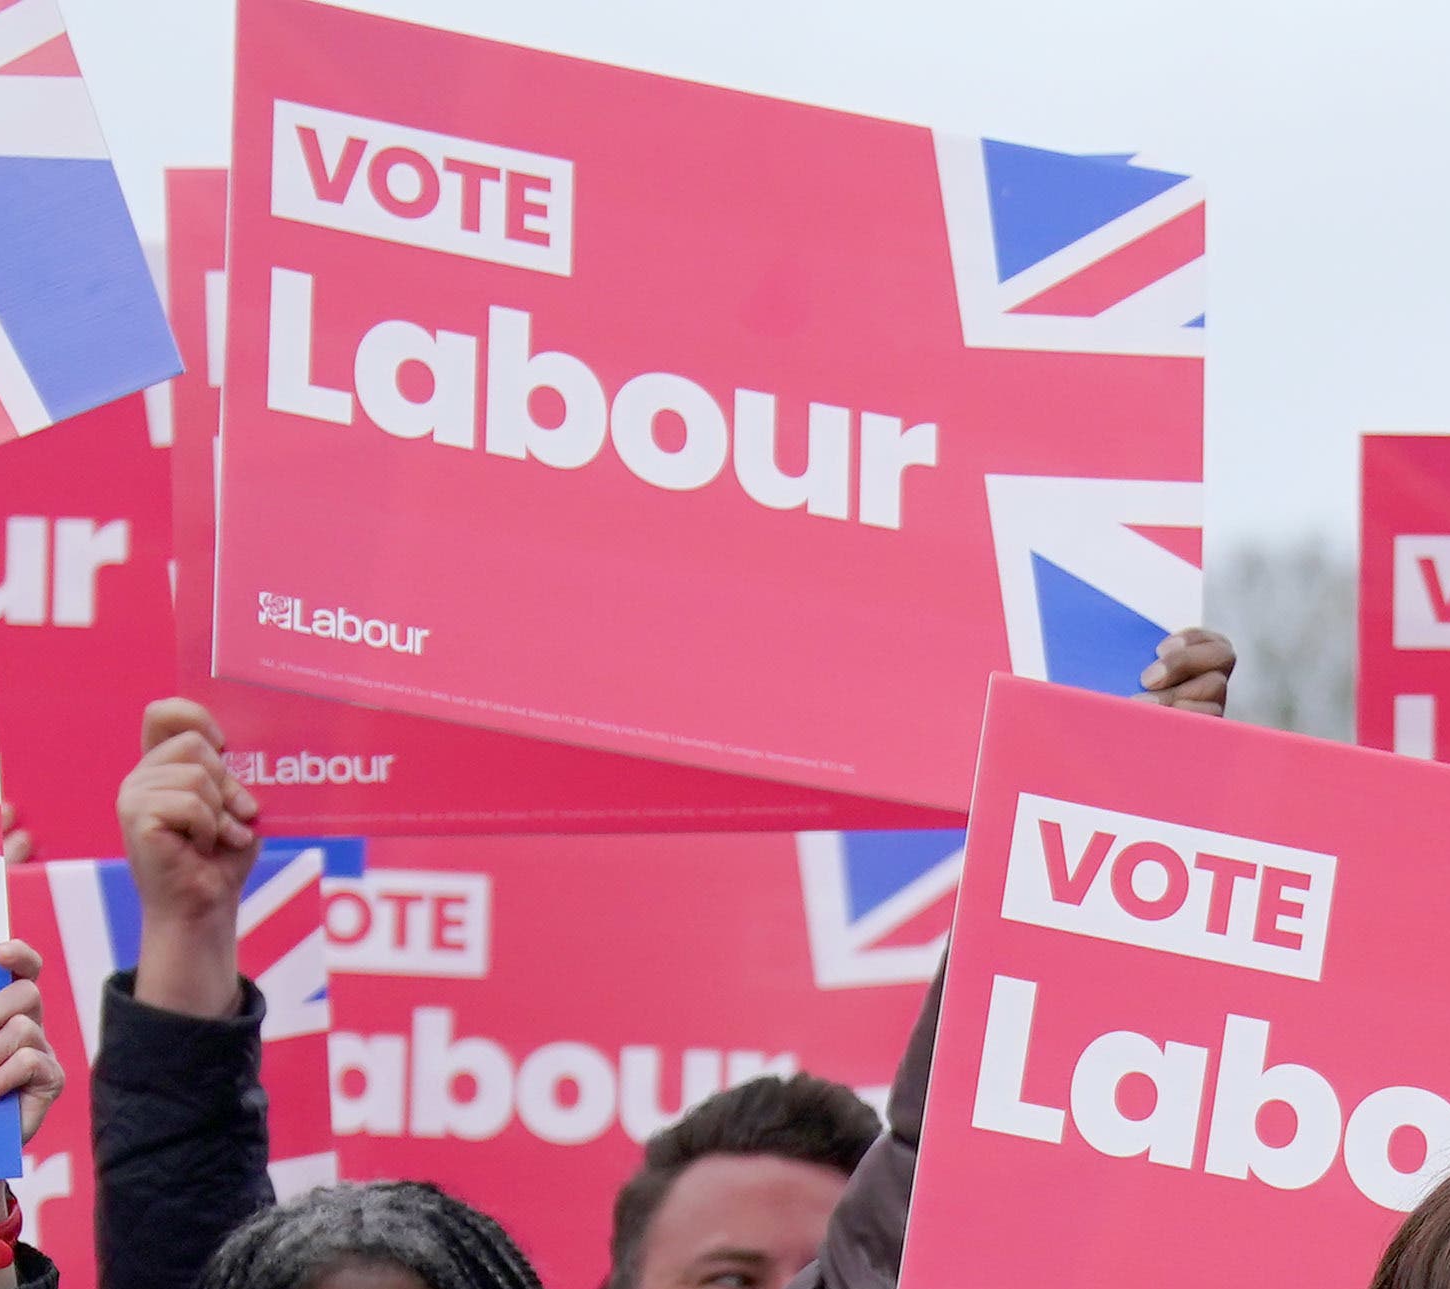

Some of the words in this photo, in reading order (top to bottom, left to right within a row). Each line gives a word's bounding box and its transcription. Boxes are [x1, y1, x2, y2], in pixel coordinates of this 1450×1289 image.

[293, 125, 552, 248] VOTE
[267, 266, 937, 530] Labour
[293, 594, 430, 657] Labour
[255, 751, 395, 786] Labour
[1038, 818, 1312, 952] VOTE
